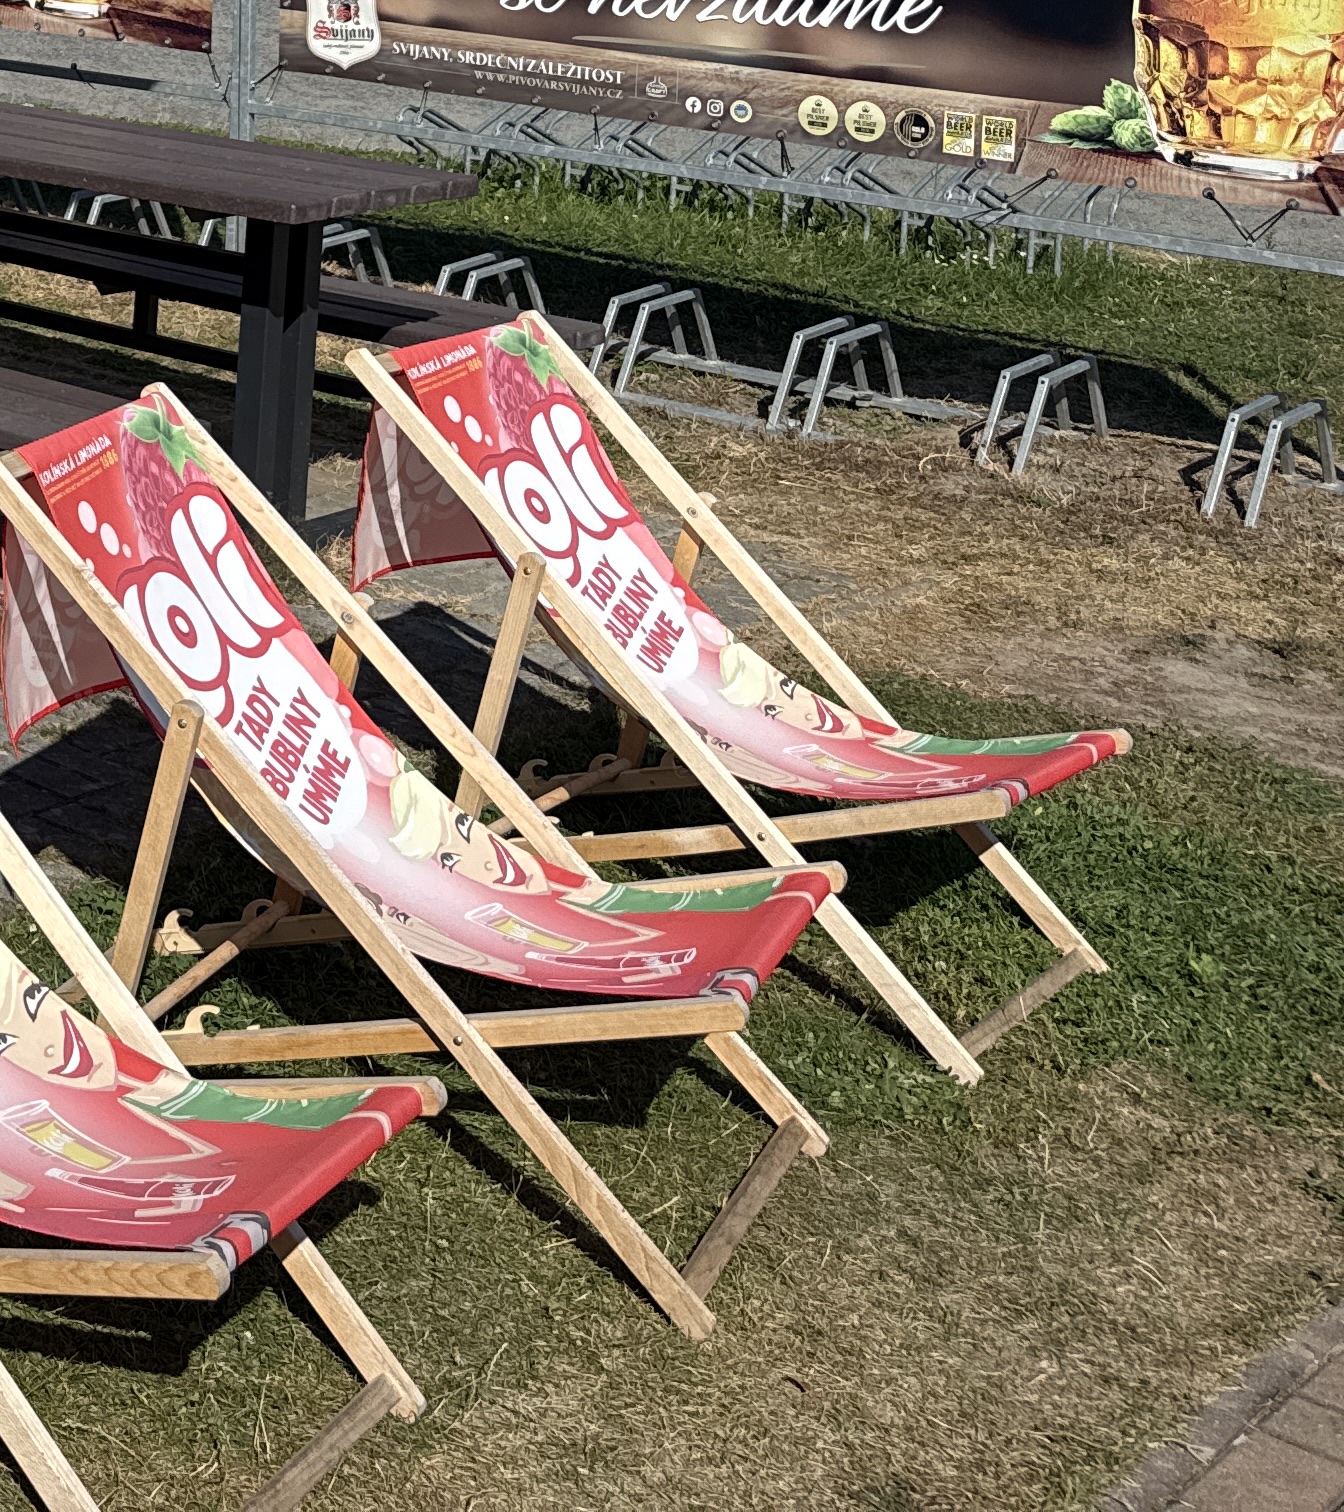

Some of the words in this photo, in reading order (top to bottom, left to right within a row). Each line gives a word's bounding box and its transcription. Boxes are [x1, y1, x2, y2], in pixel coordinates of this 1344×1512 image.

[313, 20, 374, 42] Svijany
[392, 41, 454, 64] SVIJANY,
[457, 48, 525, 73] SRDEČNÍ
[526, 57, 624, 86] ZÁLEŽITOST
[474, 70, 623, 99] WWW.PIVOVARSVIJANY.CZ
[944, 142, 972, 154] GOLD
[946, 121, 973, 132] BEER
[984, 127, 1013, 138] BEER
[581, 554, 624, 612] TADY
[637, 610, 684, 674] UMÍME
[235, 675, 280, 752] TADY
[260, 686, 320, 800] BUBLINY
[299, 739, 351, 826] UMÍME
